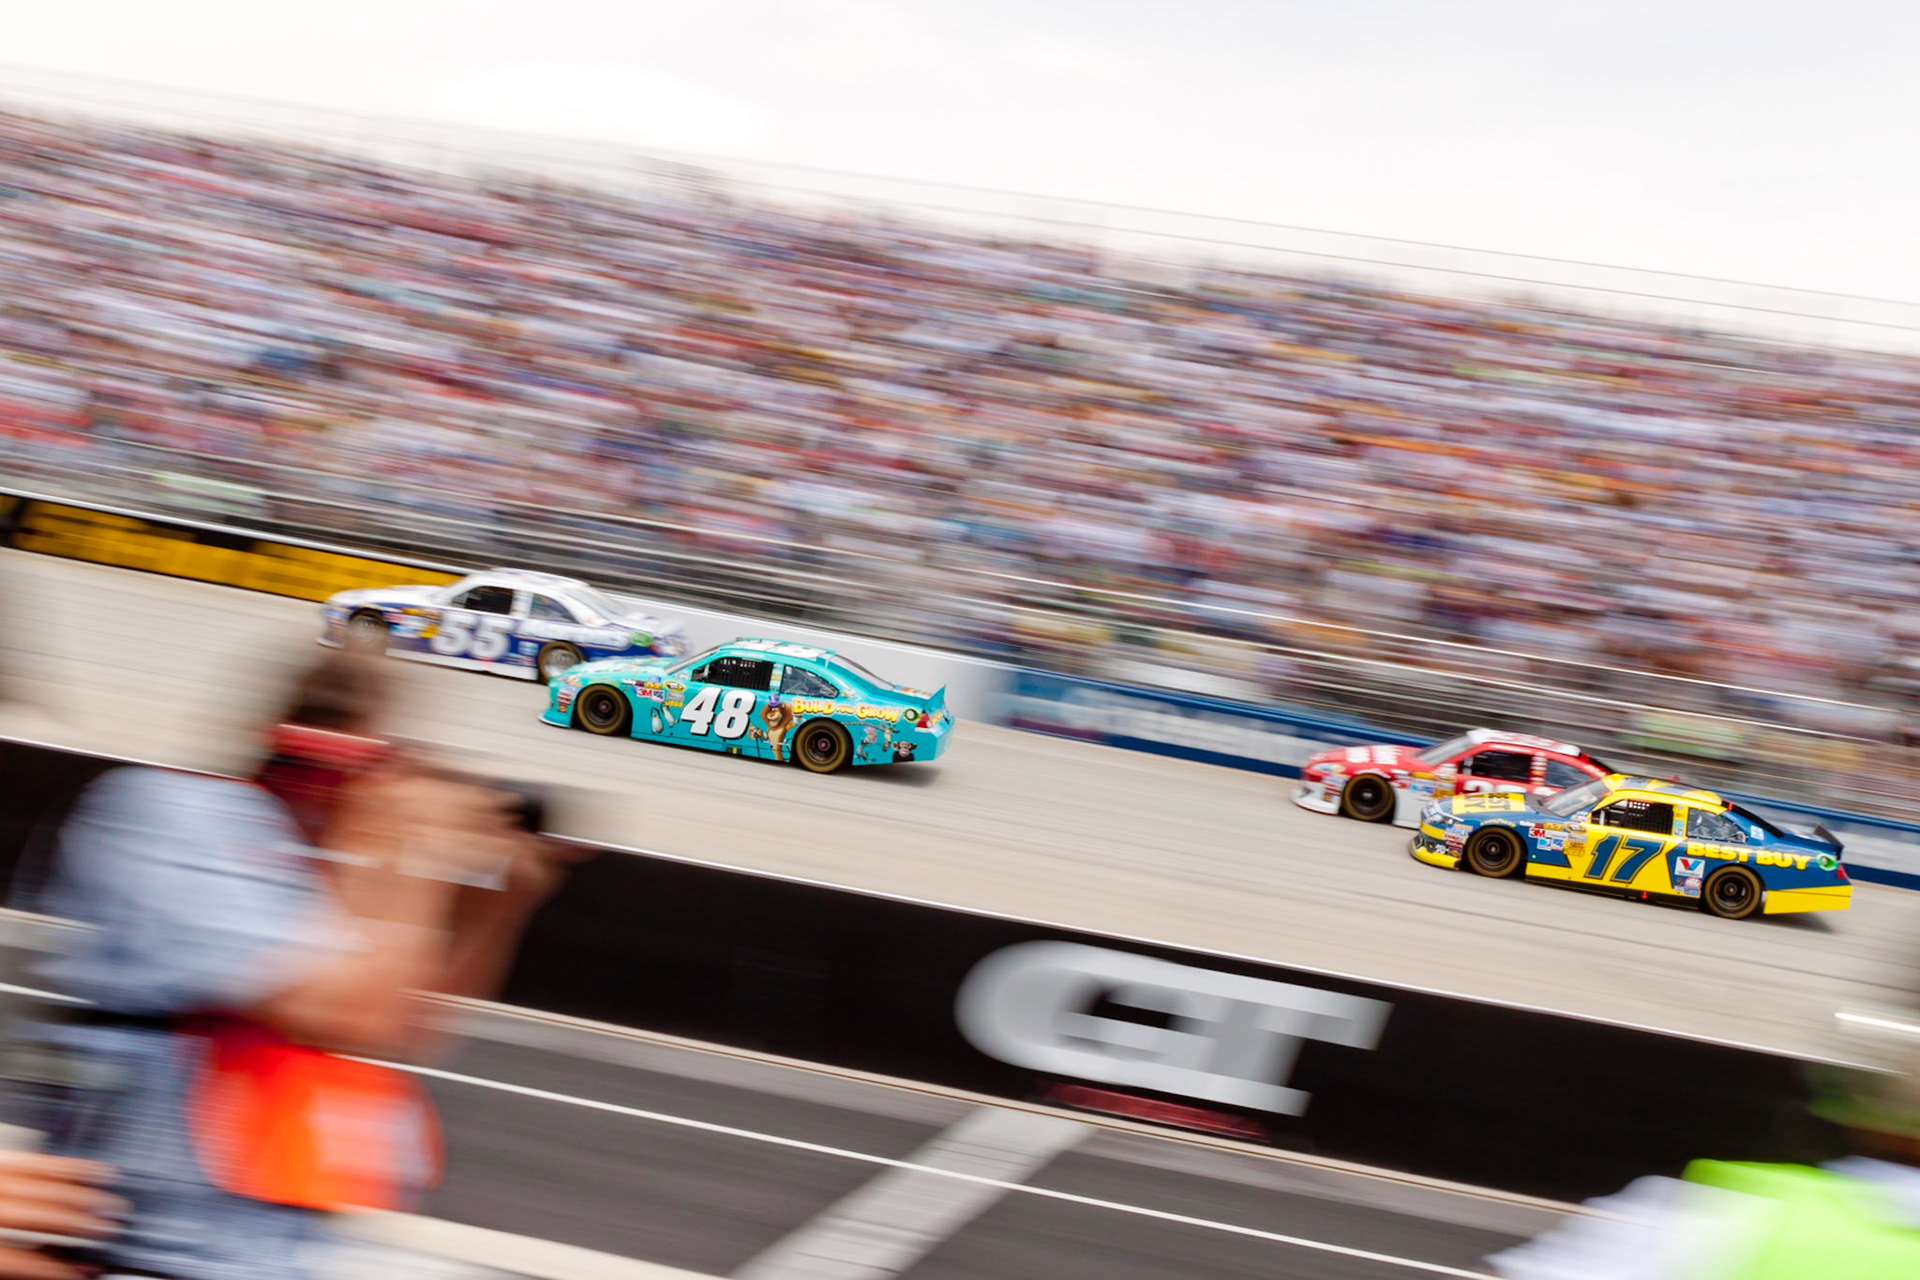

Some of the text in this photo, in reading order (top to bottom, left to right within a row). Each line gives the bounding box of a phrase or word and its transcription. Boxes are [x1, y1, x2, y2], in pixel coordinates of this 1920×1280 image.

[431, 611, 510, 659] 55
[637, 688, 652, 697] 3M
[680, 686, 756, 740] 48
[793, 698, 835, 716] BUILD
[856, 704, 901, 723] GROW
[1529, 829, 1546, 838] 3M
[1584, 833, 1666, 885] 17
[1686, 841, 1815, 871] BEST BUY
